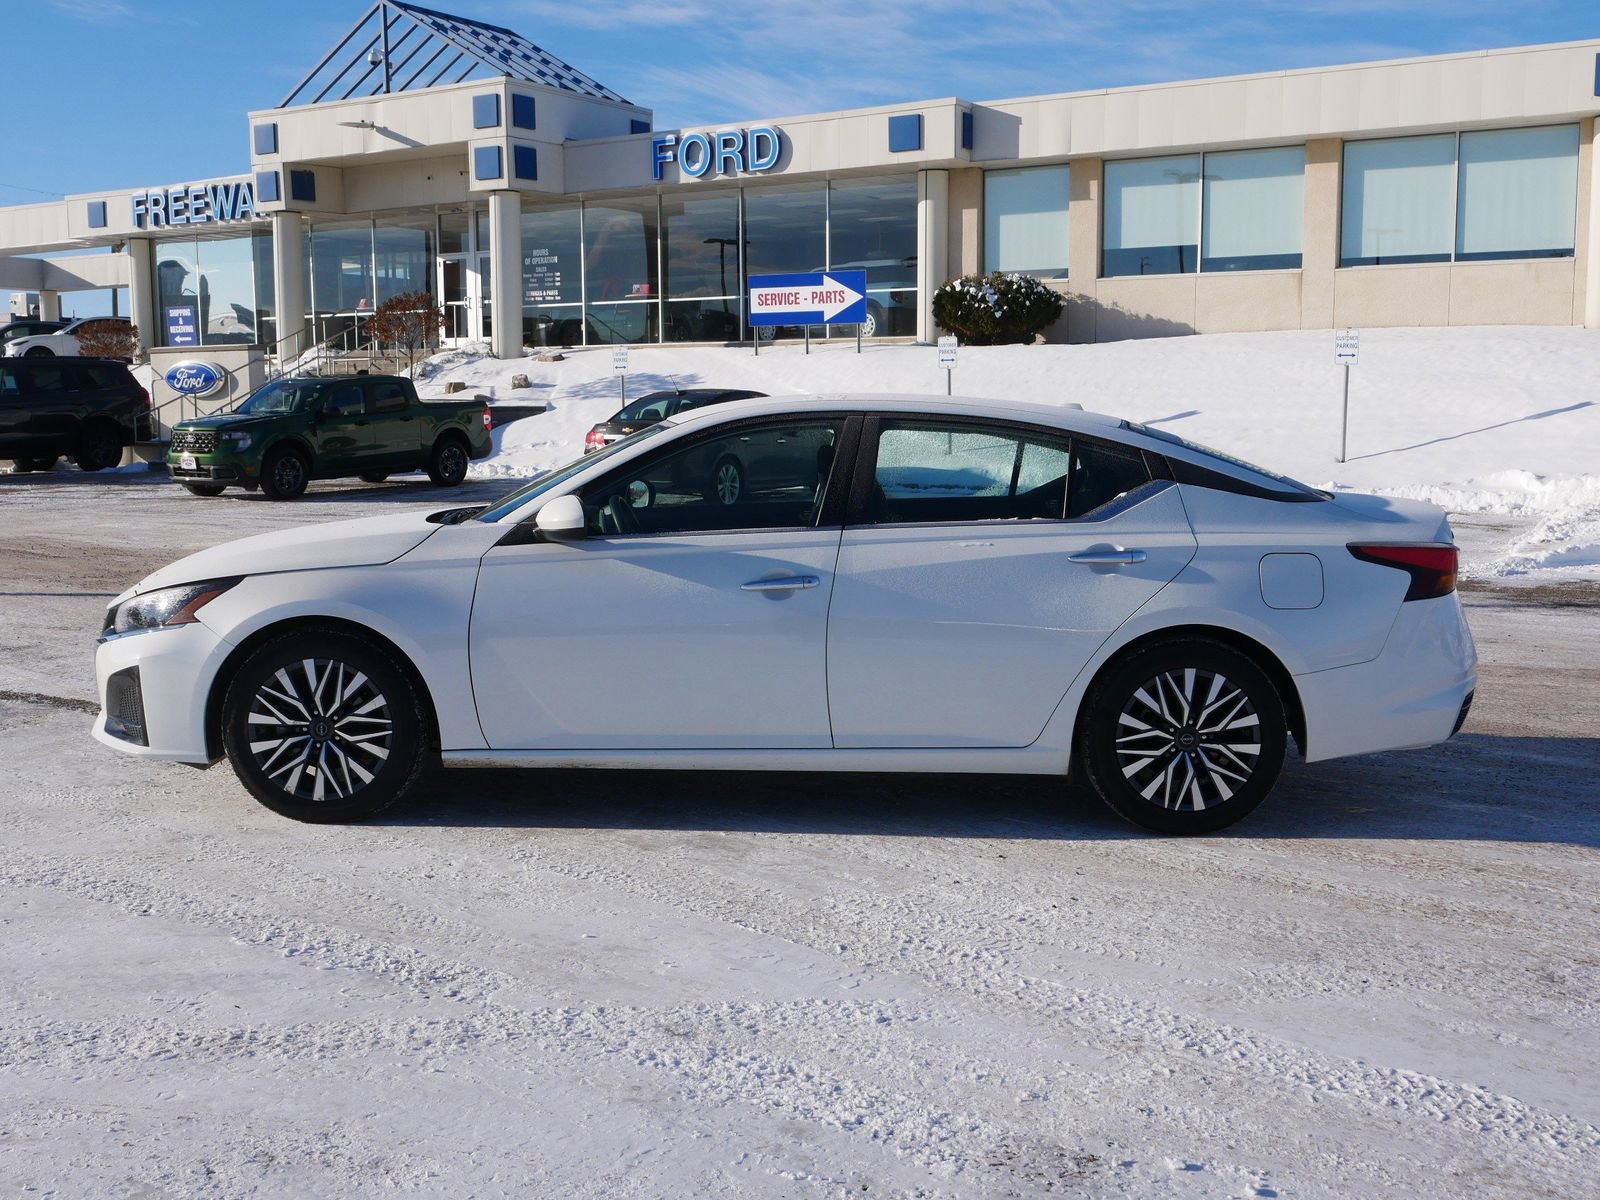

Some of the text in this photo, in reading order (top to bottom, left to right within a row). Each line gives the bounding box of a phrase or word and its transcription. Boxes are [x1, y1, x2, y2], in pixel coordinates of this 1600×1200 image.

[653, 126, 779, 180] FORD
[132, 182, 258, 227] FREEWA
[532, 256, 557, 264] OPERATION
[758, 292, 800, 306] SERVICE
[811, 290, 845, 304] PARTS
[174, 367, 205, 388] Ford
